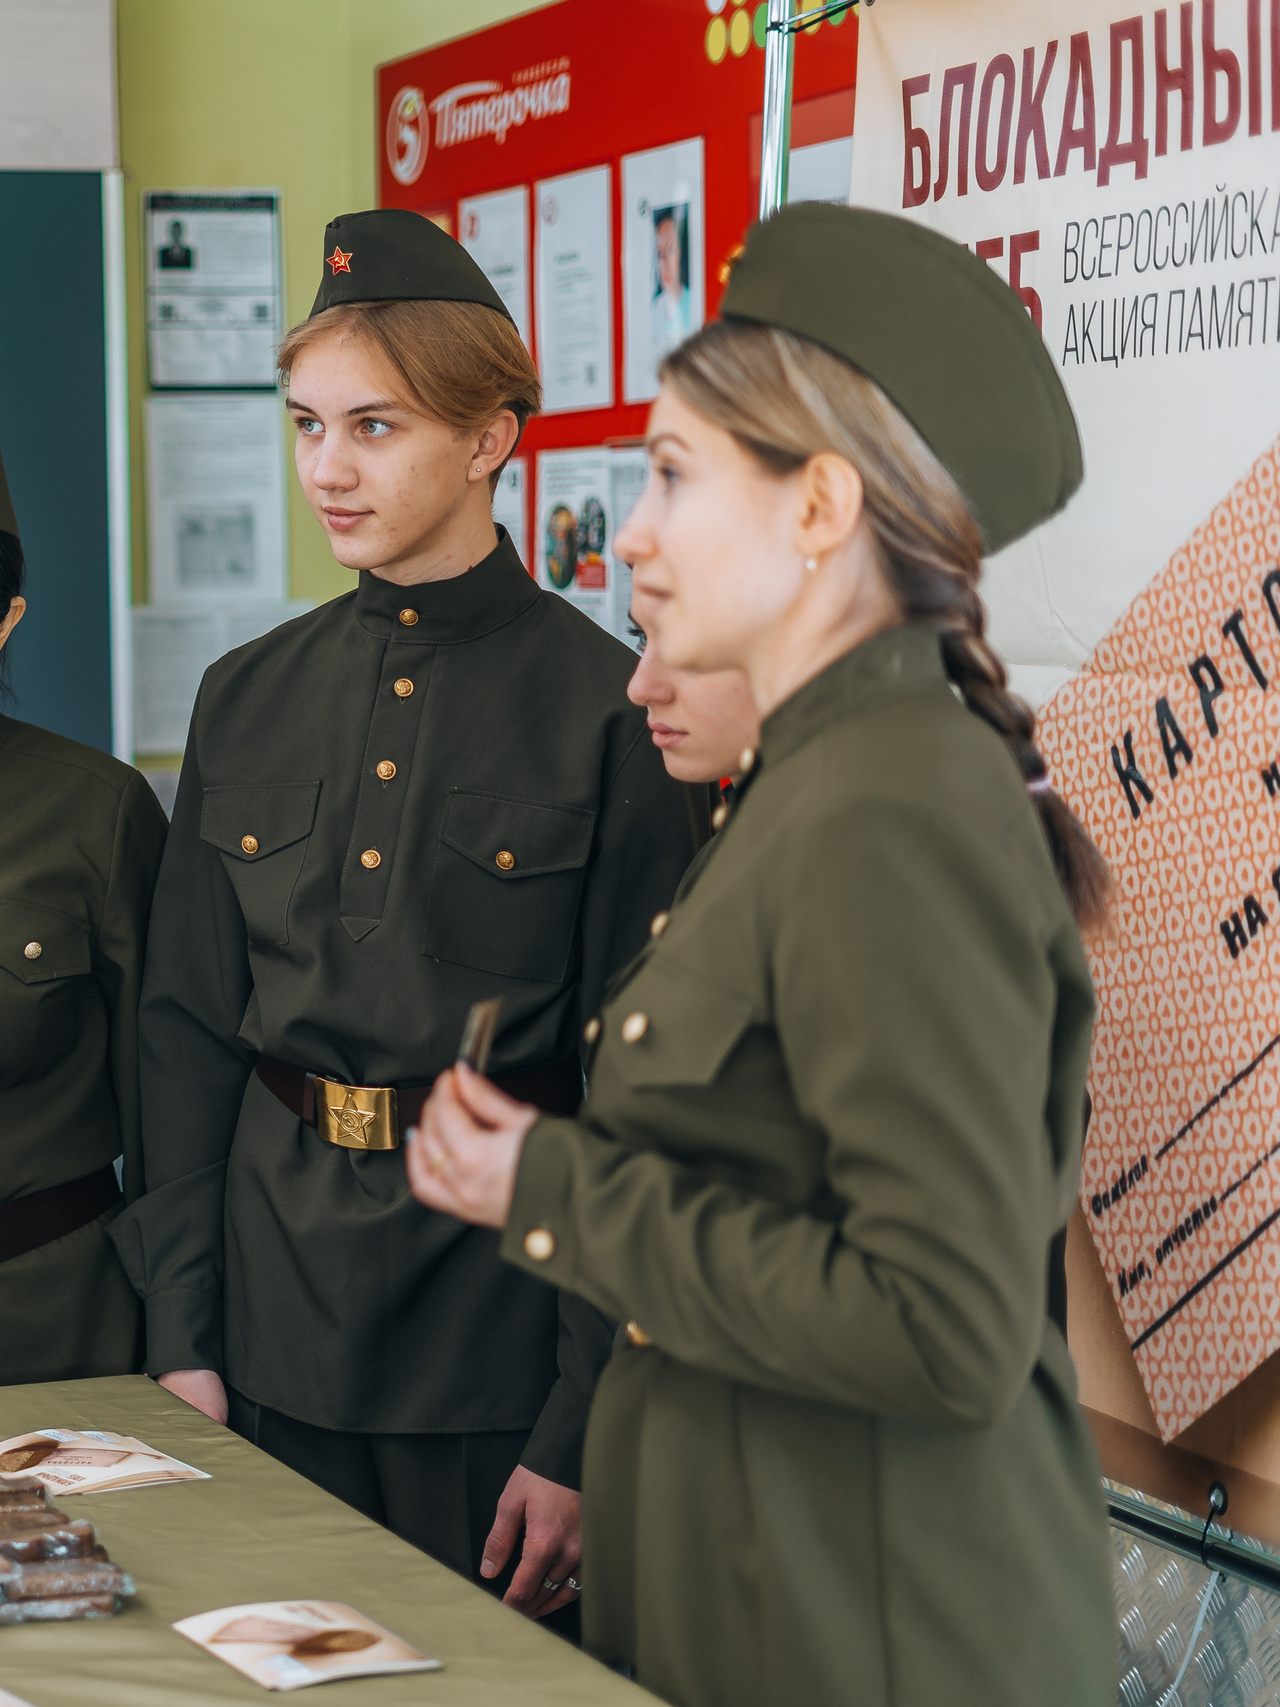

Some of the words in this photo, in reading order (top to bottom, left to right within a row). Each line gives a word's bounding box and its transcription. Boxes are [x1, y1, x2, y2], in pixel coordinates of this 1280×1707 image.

[901, 0, 1280, 209] БЛОКАДНЫ
[1062, 293, 1158, 368] АКЦИЯ
[1165, 275, 1280, 355] ПАМЯТ
[1155, 1195, 1219, 1267] отчество
